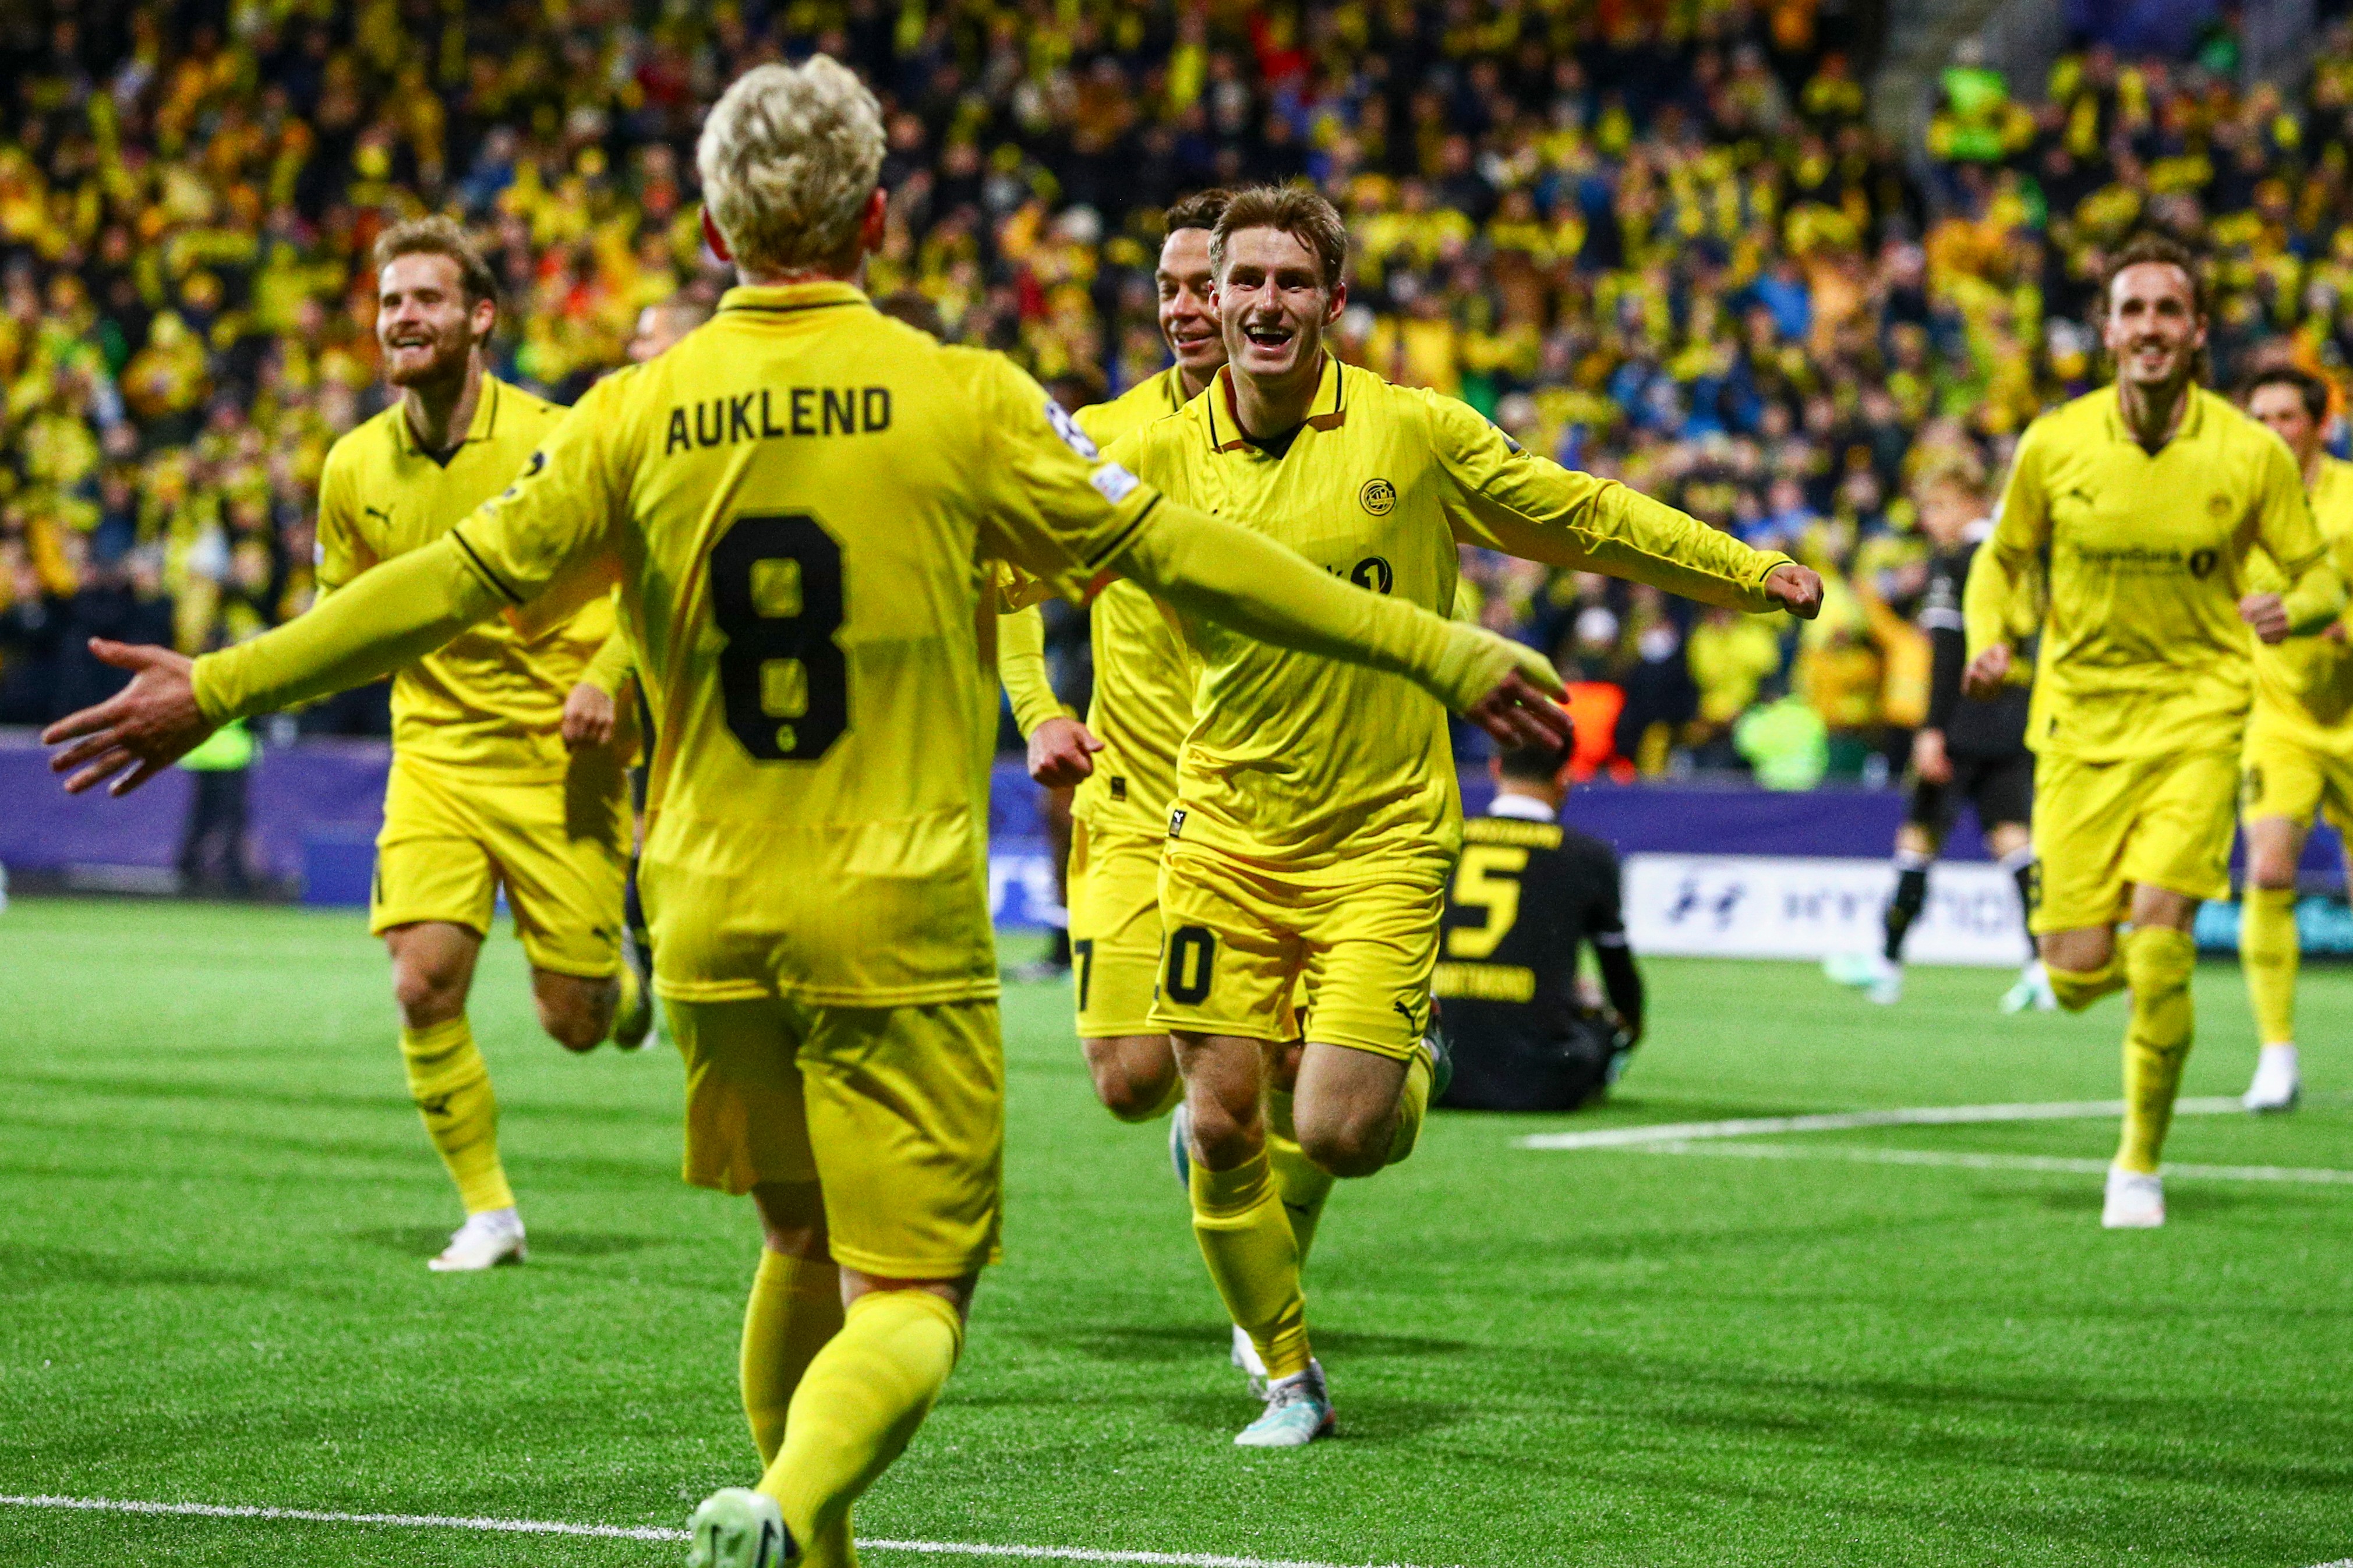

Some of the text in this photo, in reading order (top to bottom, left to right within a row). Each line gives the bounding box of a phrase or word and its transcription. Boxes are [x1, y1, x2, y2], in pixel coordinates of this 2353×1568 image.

[665, 386, 892, 456] AUKLEND
[709, 514, 851, 761] 8
[1447, 844, 1531, 959] 5
[1154, 924, 1216, 1007] 0
